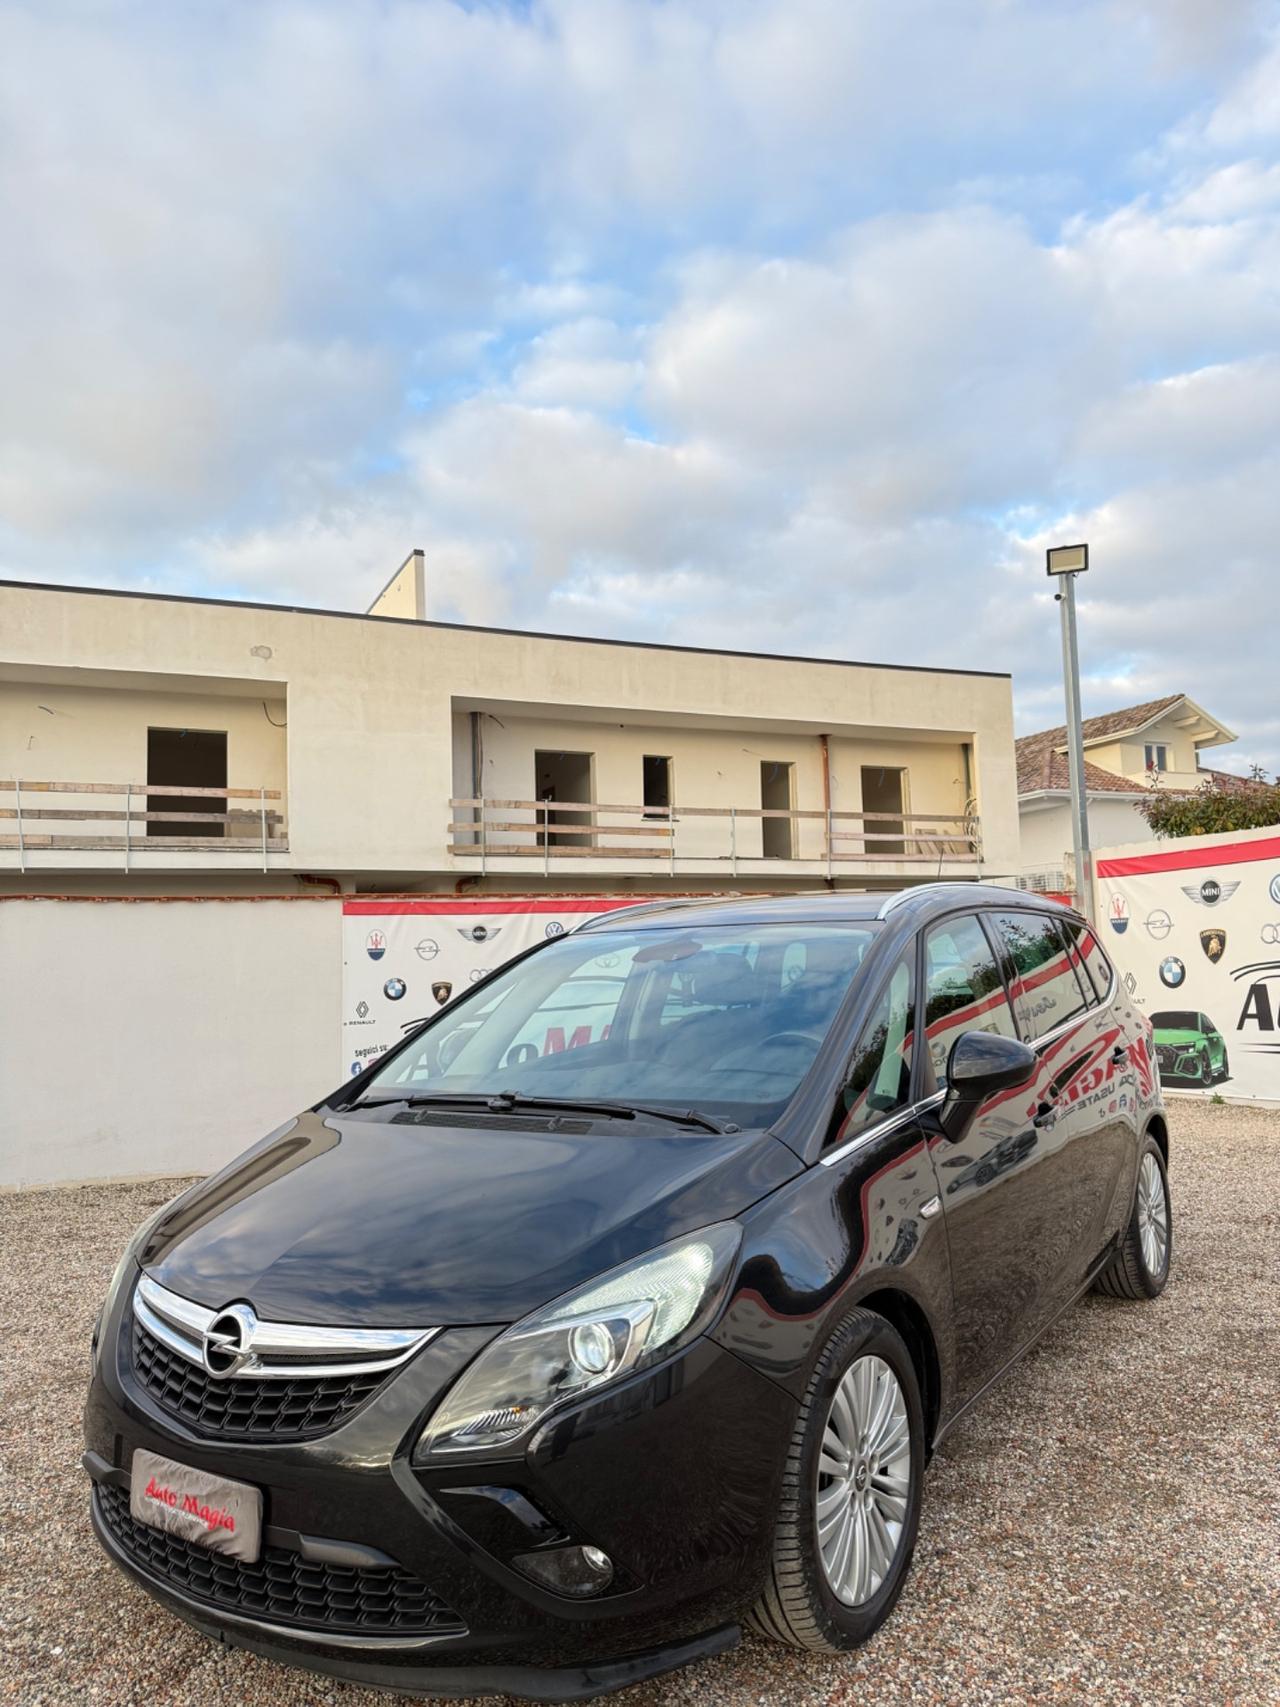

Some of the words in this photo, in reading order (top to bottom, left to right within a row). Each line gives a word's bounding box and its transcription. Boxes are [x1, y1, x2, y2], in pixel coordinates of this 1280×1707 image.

[1201, 888, 1220, 896] MINI
[1236, 984, 1280, 1031] A
[145, 1476, 177, 1506] Auto
[183, 1495, 235, 1531] Magia
